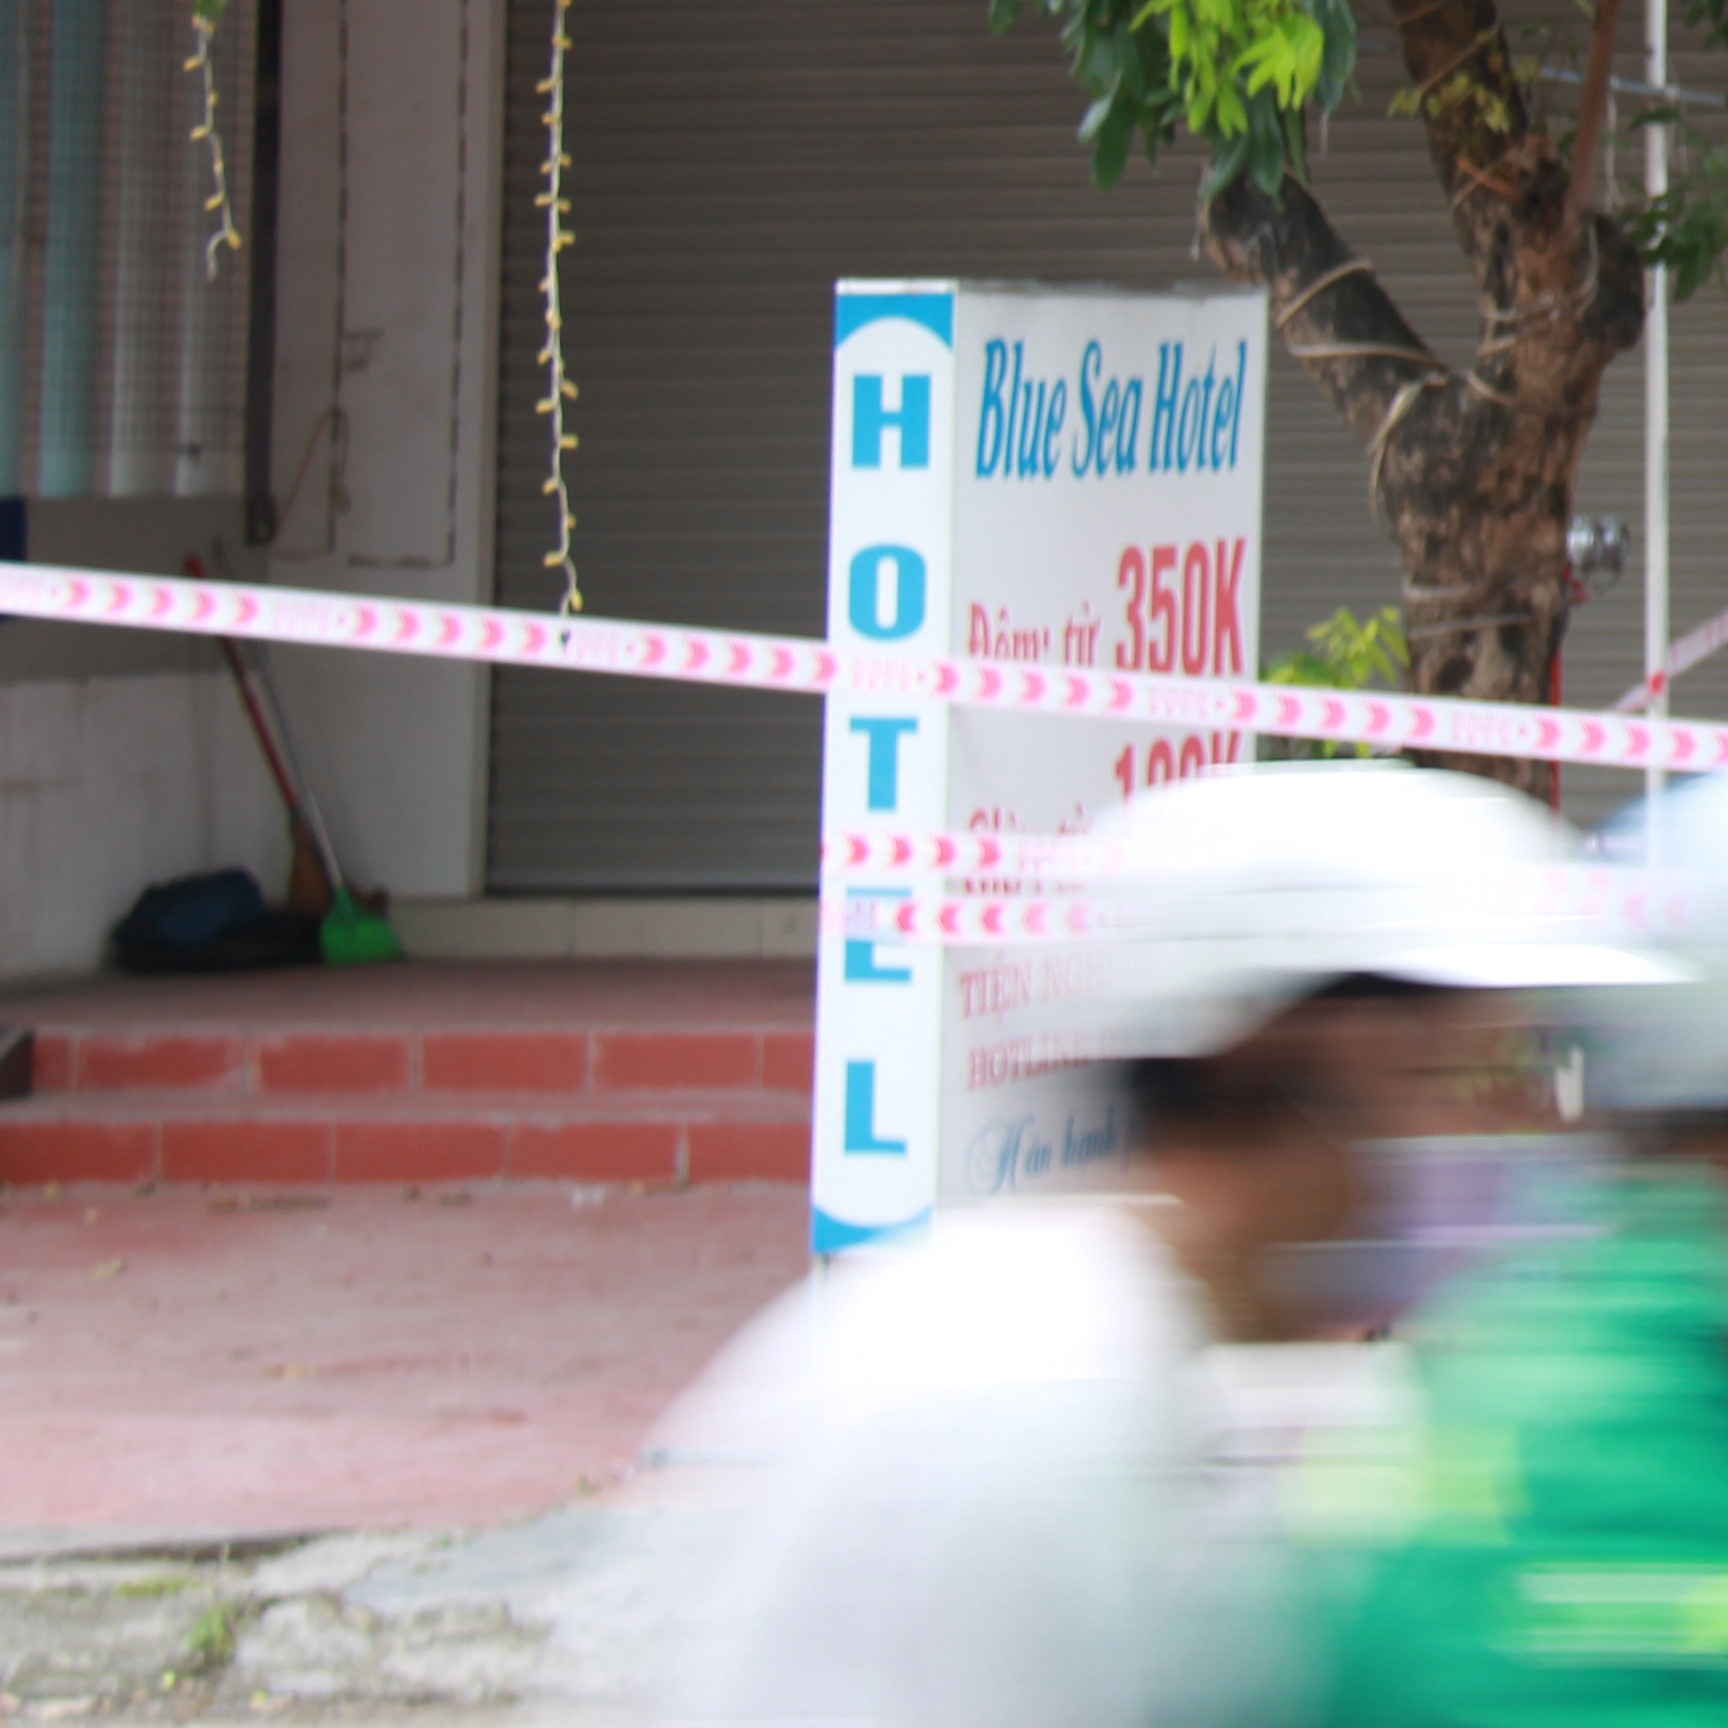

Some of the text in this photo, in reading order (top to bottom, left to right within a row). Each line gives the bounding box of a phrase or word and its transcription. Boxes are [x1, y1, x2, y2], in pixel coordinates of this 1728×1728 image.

[976, 337, 1247, 480] Blue Sea Hotel
[1116, 539, 1248, 677] 350K
[842, 373, 932, 1155] HOTEL
